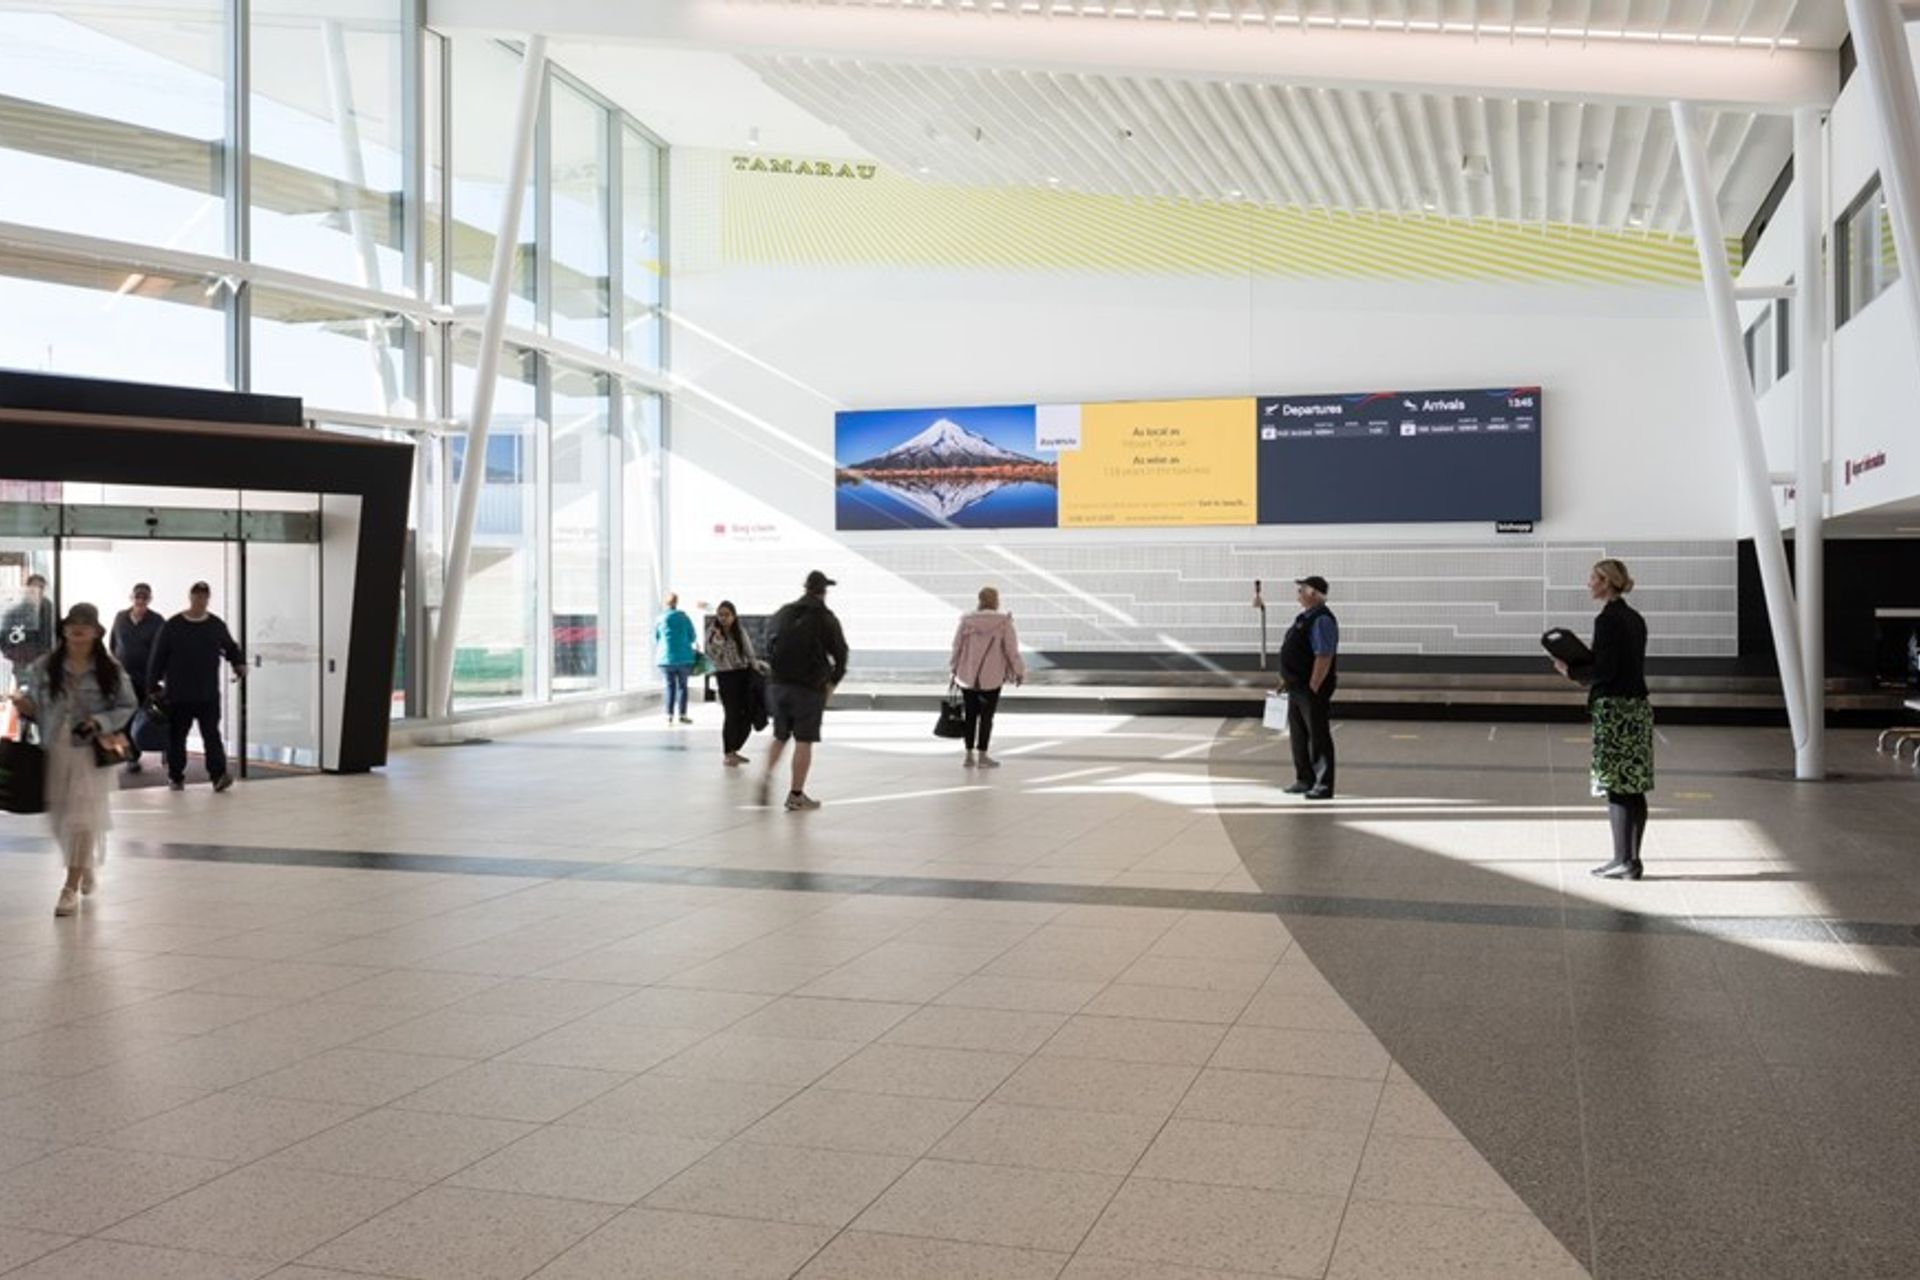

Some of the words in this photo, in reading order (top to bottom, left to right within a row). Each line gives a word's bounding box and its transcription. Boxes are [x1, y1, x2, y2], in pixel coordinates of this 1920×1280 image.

[732, 156, 876, 179] TAMARAU
[1282, 404, 1343, 418] Departures
[1422, 398, 1465, 411] Arrivals
